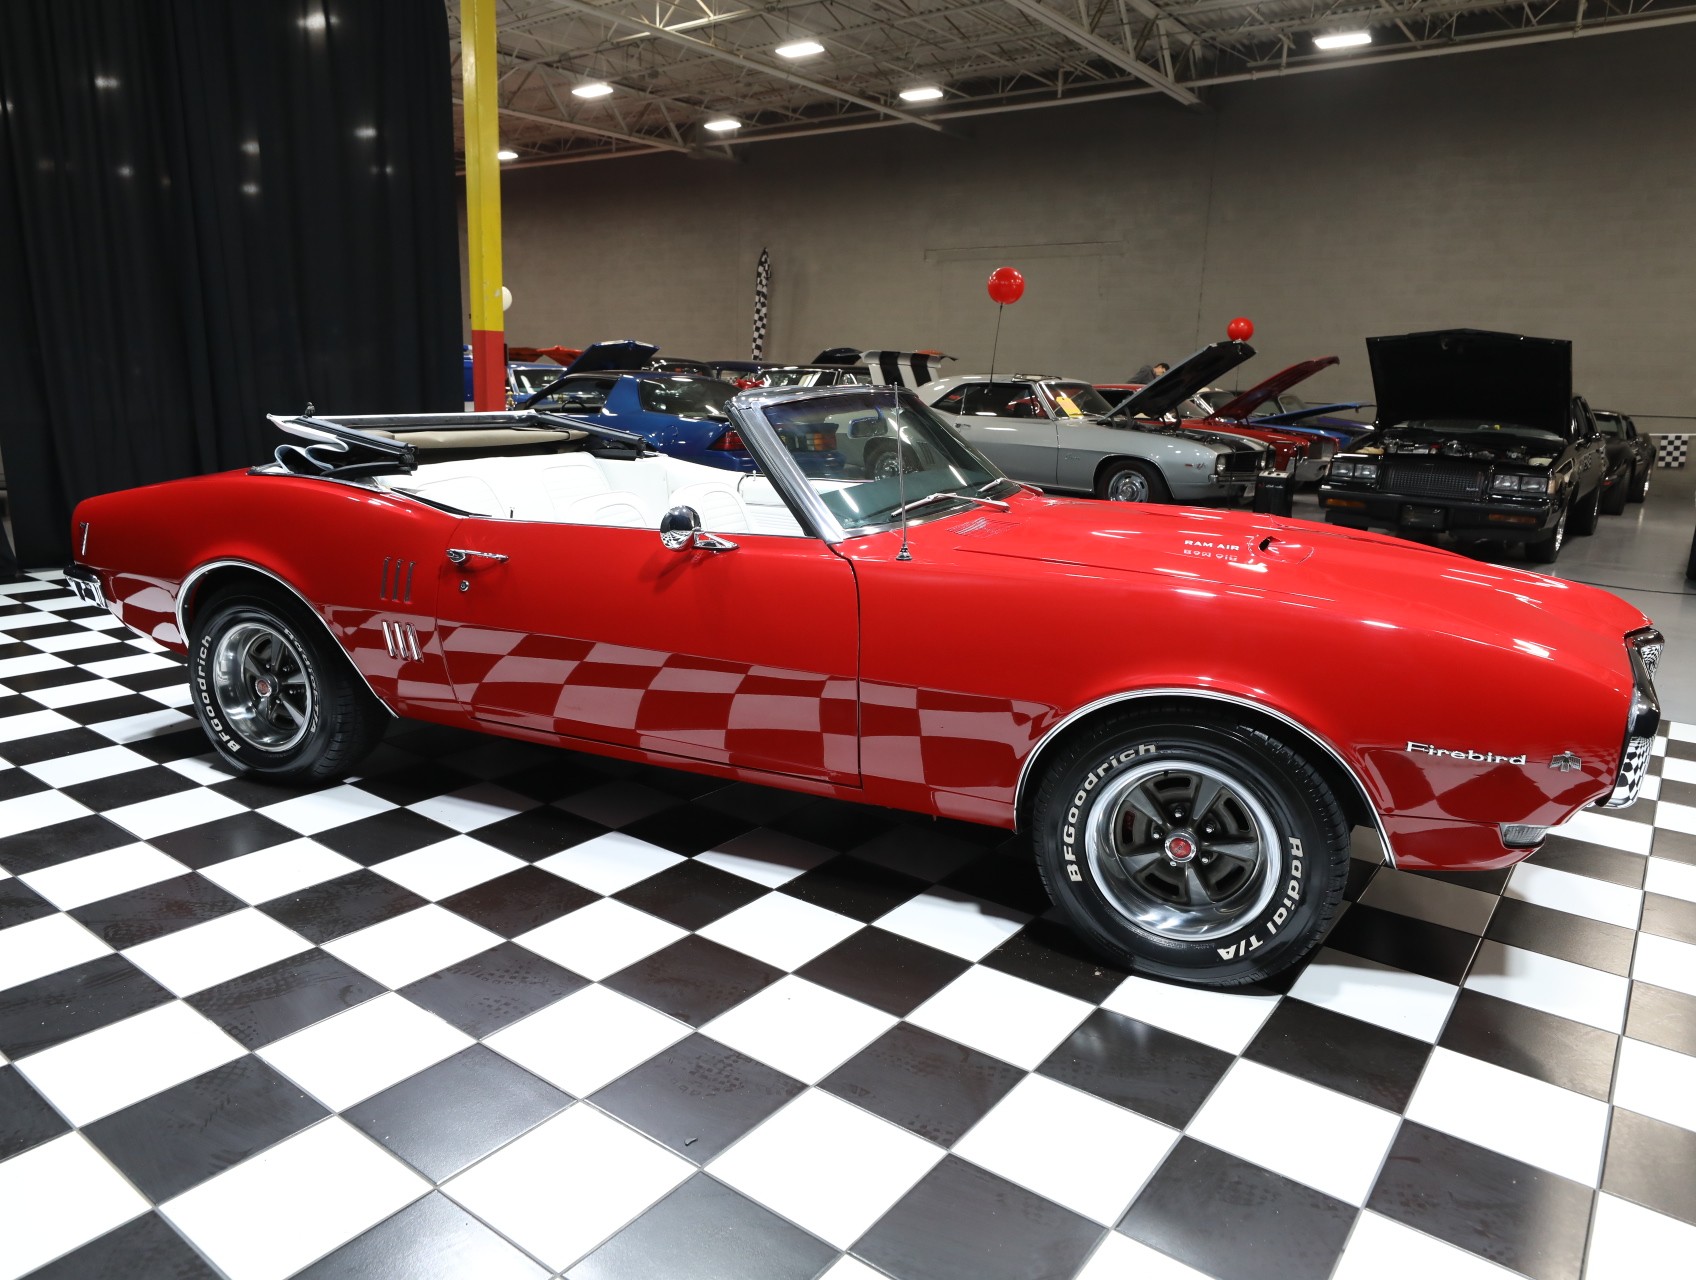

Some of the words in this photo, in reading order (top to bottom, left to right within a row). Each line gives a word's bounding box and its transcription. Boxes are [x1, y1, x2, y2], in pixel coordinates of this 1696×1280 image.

[1184, 540, 1213, 548] RAM
[196, 635, 241, 752] BFGoodrich
[1406, 741, 1527, 765] Firebird
[1063, 744, 1156, 882] BFGoodrich
[1266, 836, 1304, 935] Radial
[1217, 938, 1263, 960] T/A
